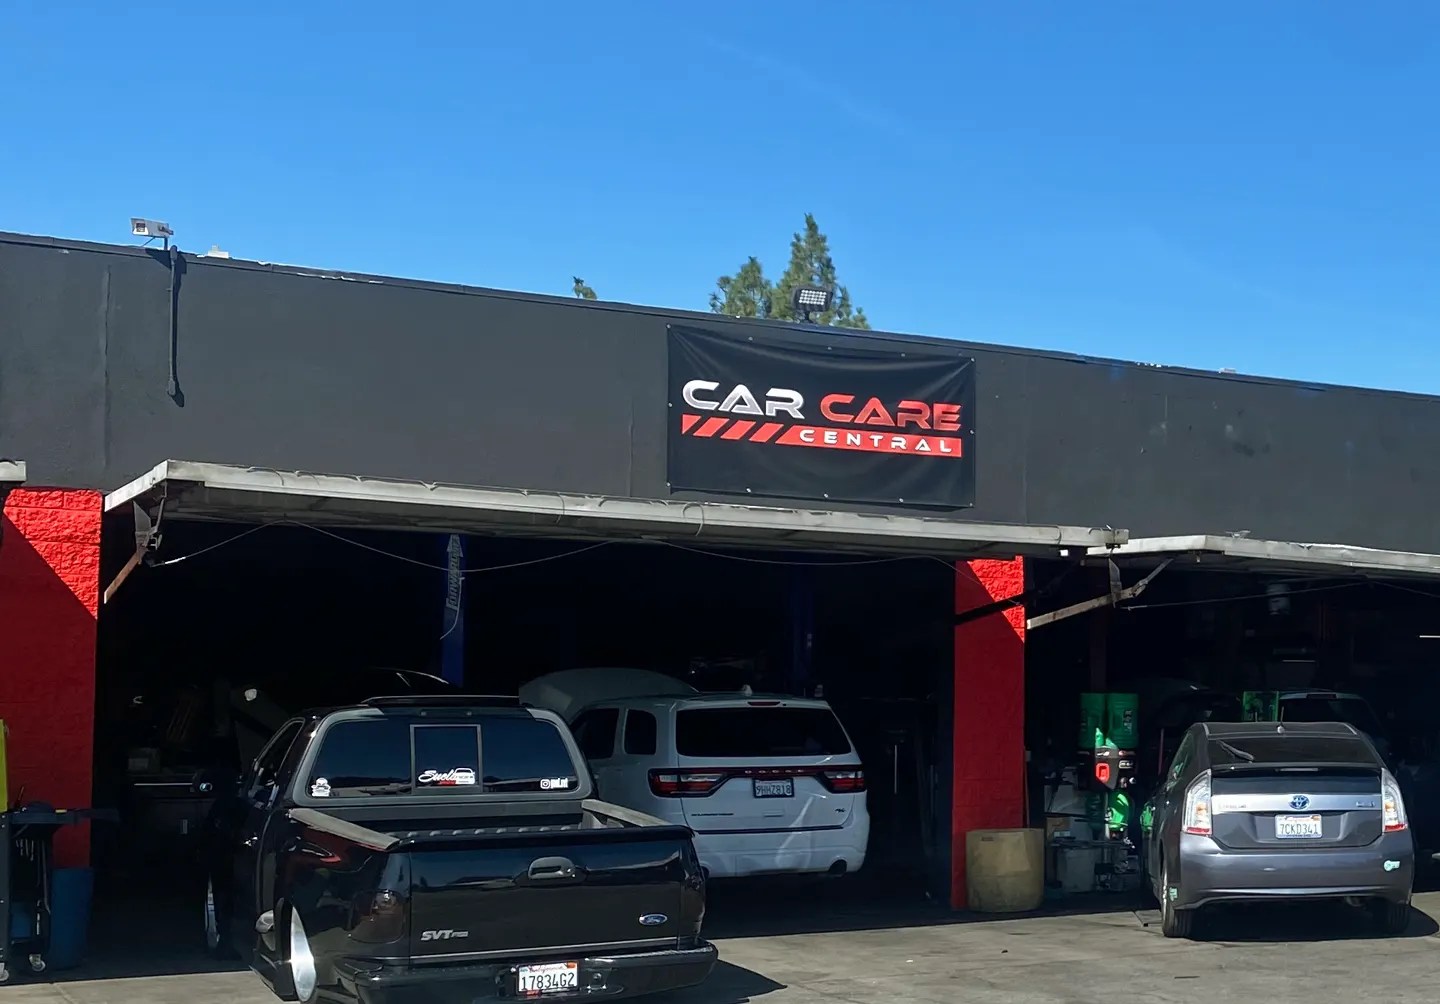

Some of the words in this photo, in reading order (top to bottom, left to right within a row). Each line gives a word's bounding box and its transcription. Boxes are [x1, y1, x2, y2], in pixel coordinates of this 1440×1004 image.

[682, 379, 805, 419] CAR
[820, 393, 962, 431] CARE
[799, 429, 953, 453] CENTRAL
[1280, 823, 1318, 835] 7CKD341
[420, 929, 453, 941] SVT
[521, 972, 575, 991] 17834G2
